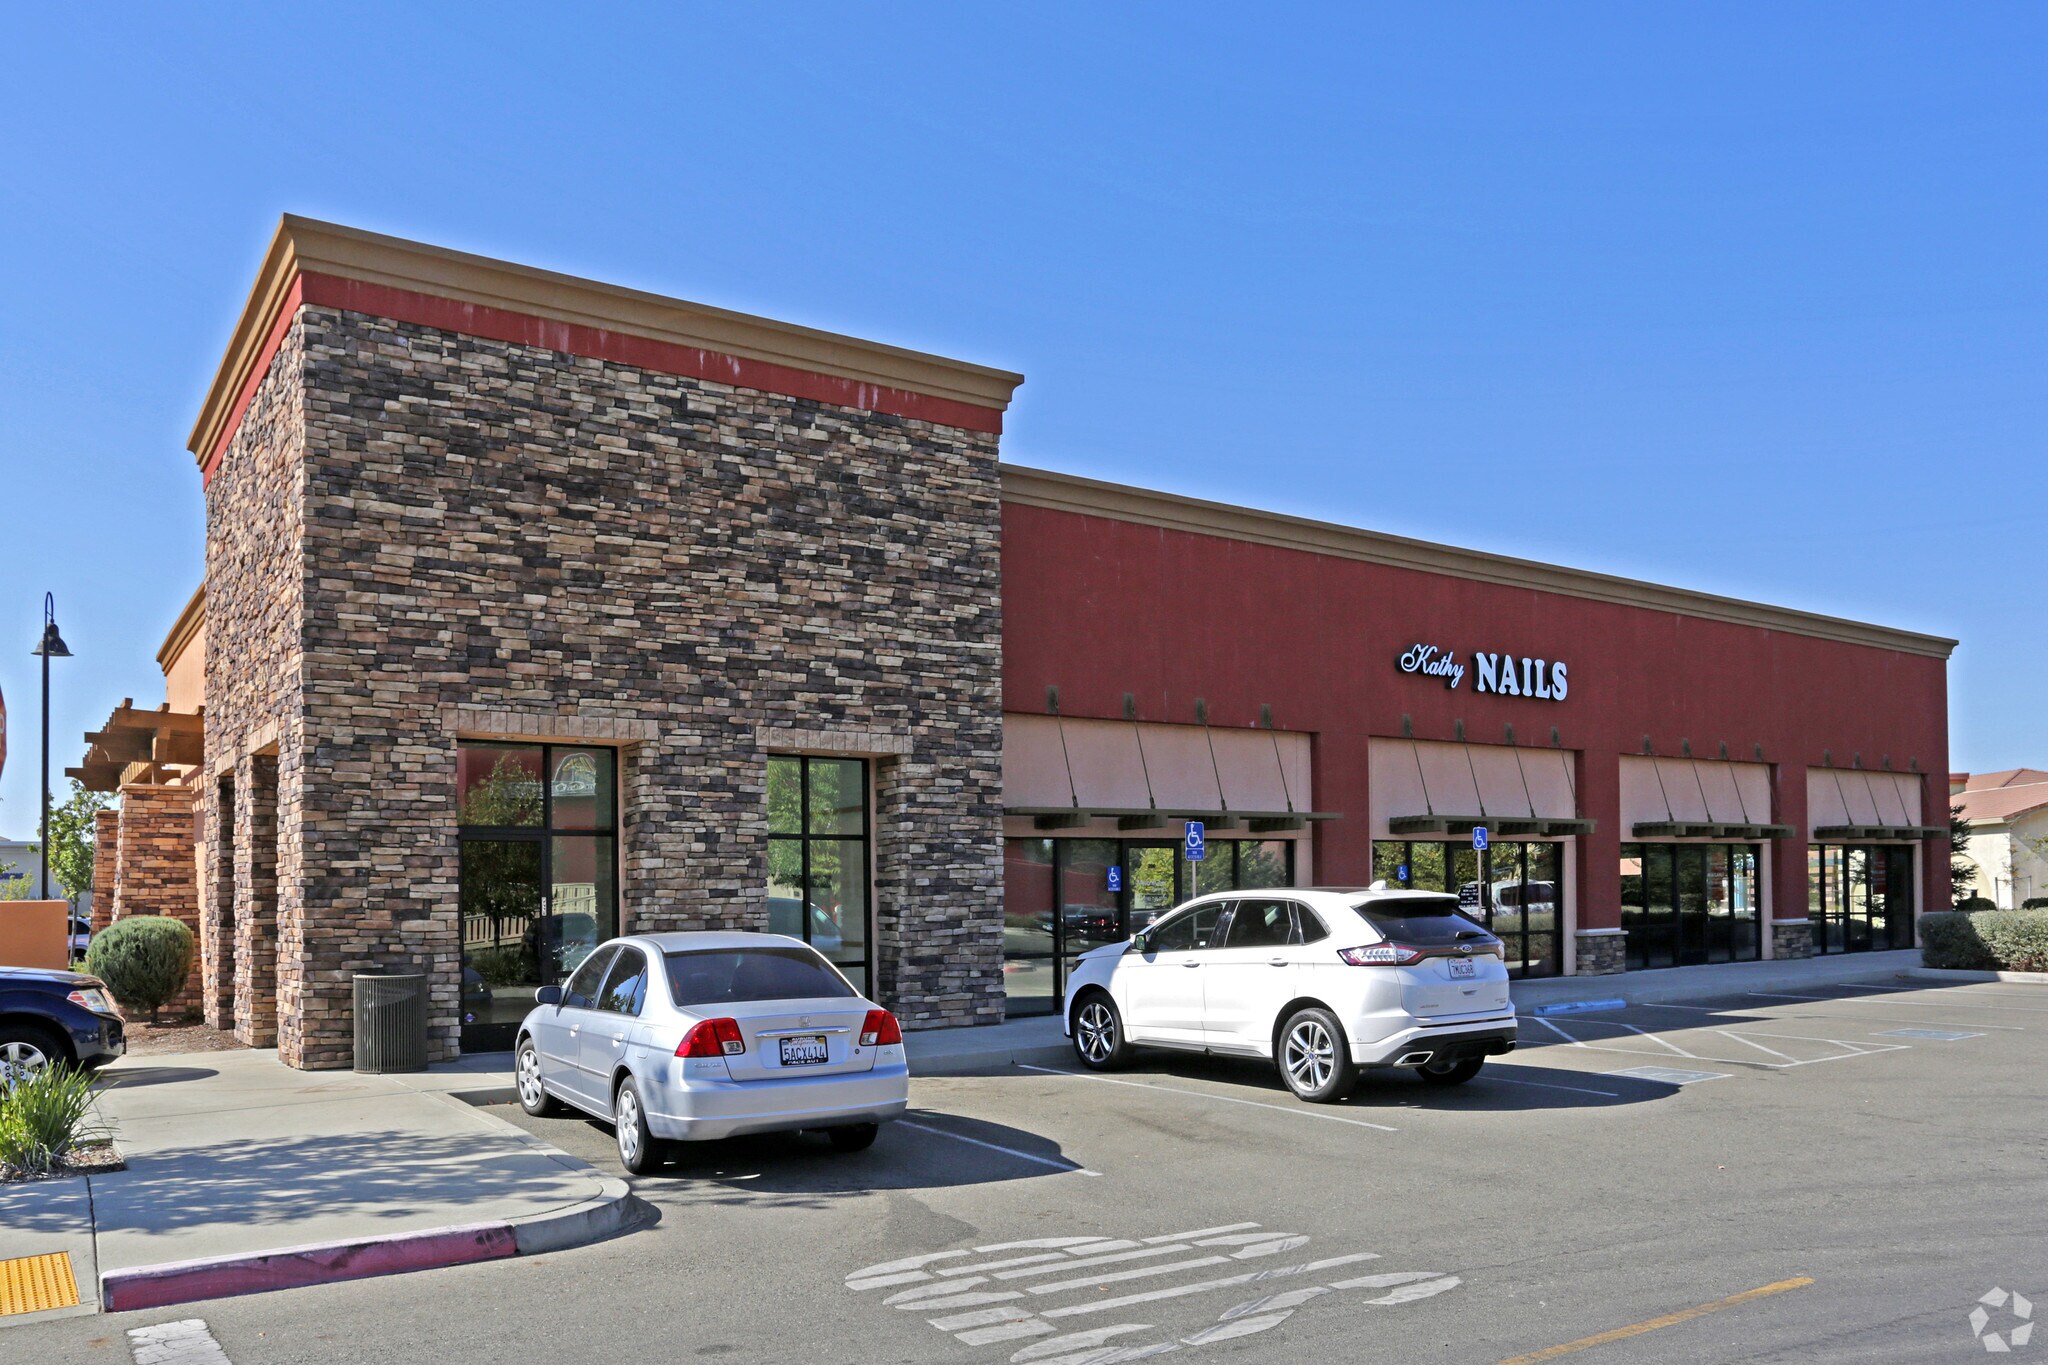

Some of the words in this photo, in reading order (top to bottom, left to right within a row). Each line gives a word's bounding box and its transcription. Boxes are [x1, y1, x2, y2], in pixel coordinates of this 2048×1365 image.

[1400, 643, 1464, 689] Kathy
[1475, 652, 1568, 701] NAILS
[783, 1045, 825, 1061] 5ACX414
